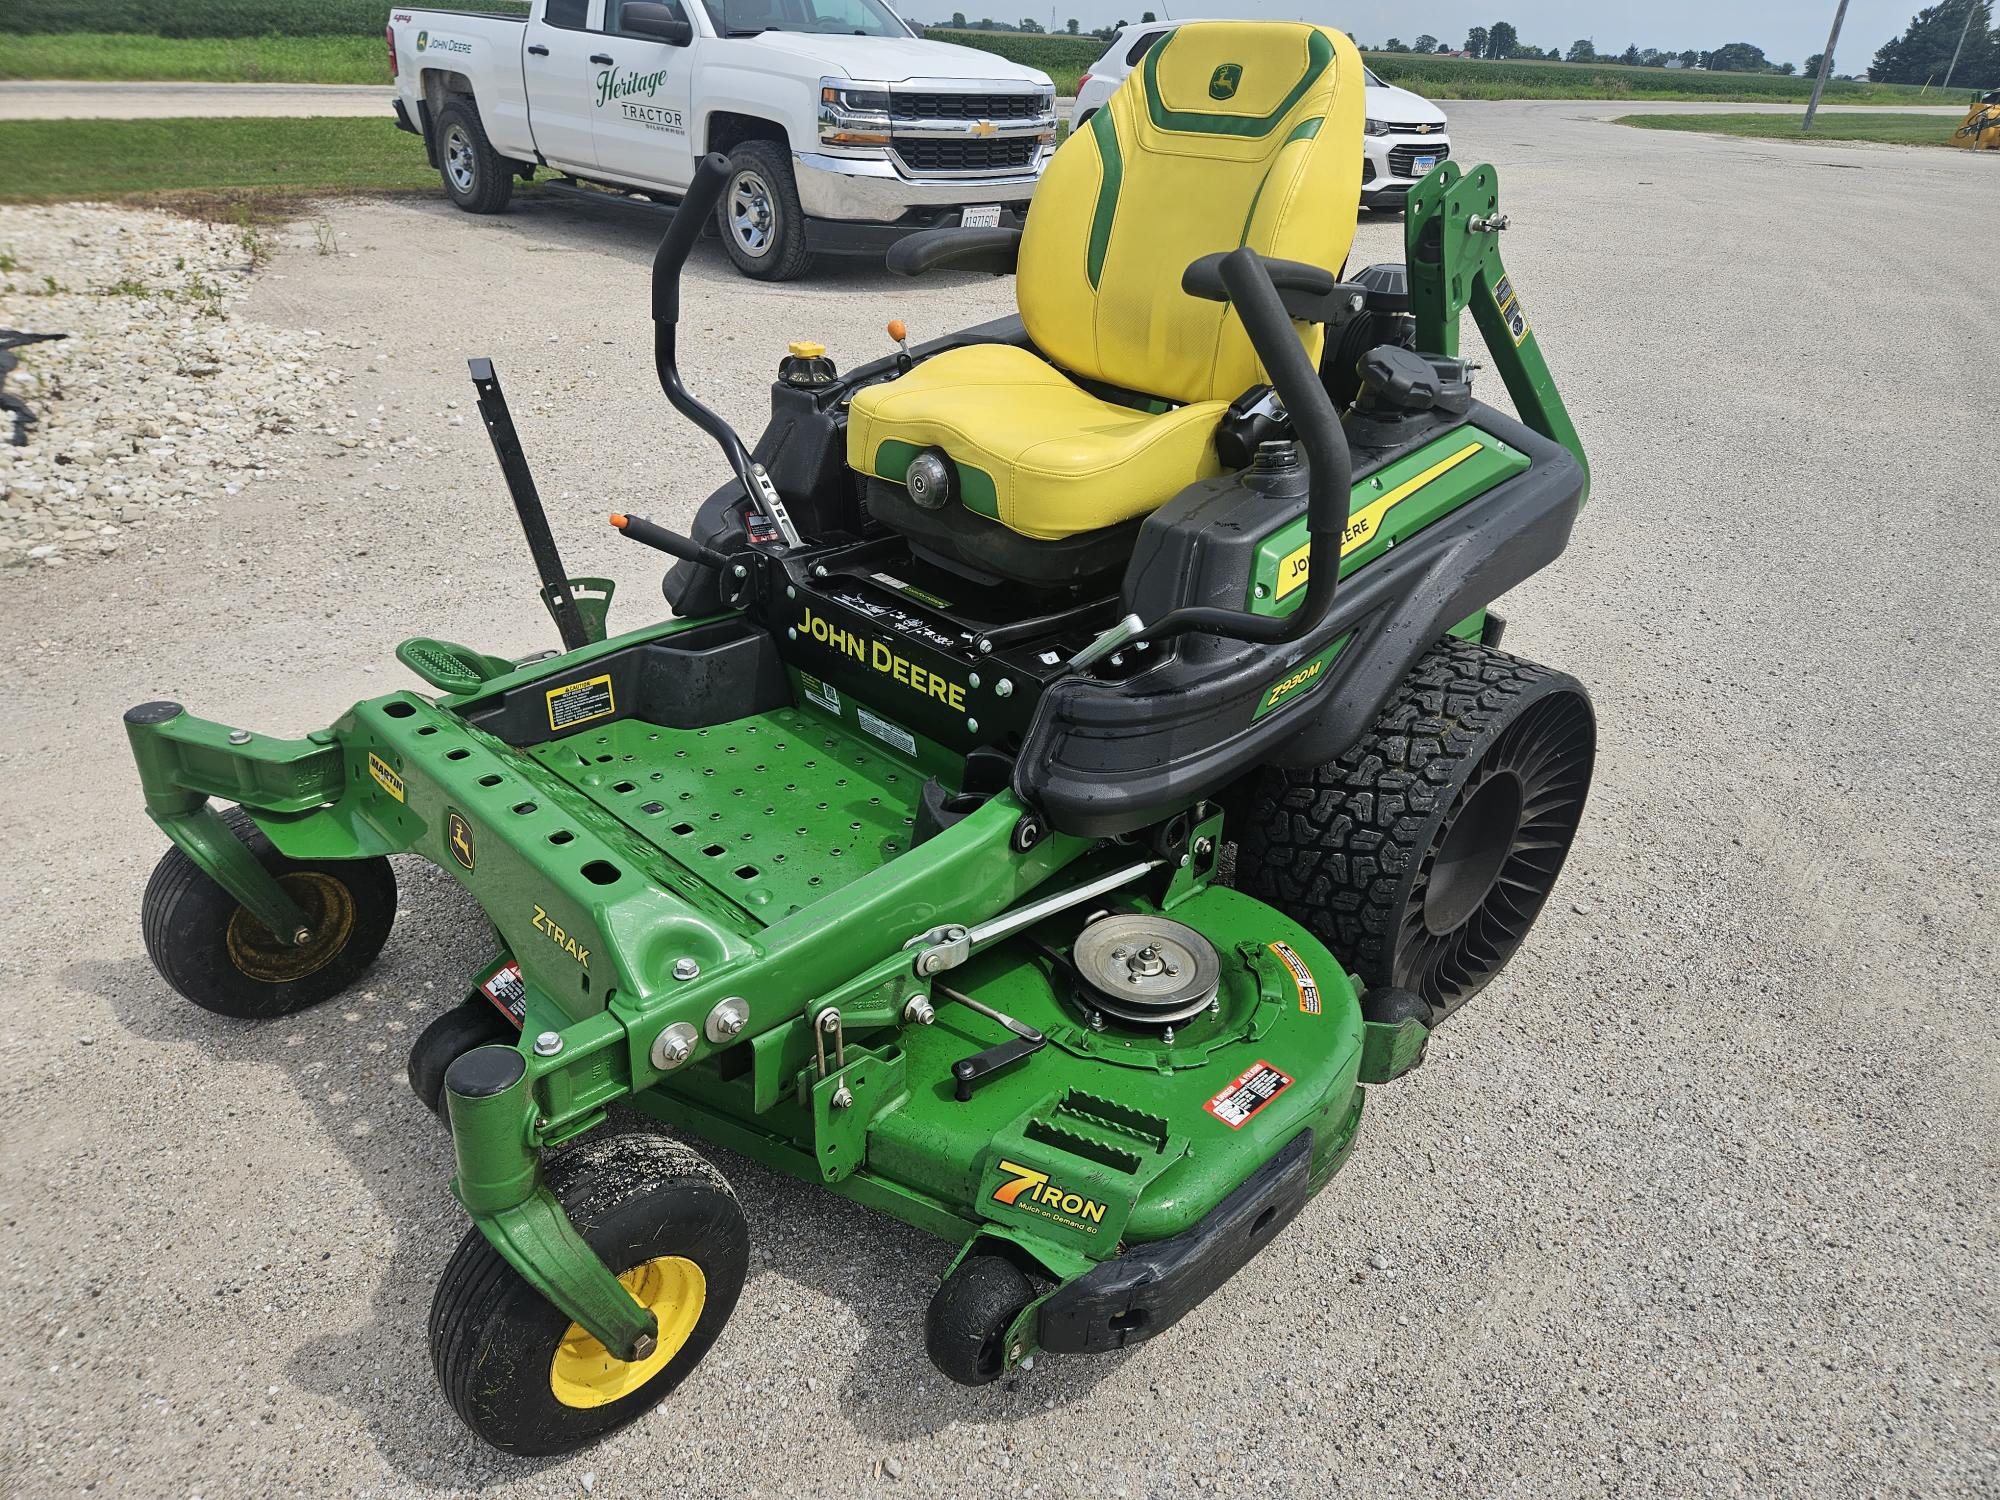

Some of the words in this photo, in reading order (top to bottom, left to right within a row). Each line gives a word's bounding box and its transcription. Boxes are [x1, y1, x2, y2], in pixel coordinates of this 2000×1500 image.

[429, 37, 448, 50] JOHN
[448, 40, 472, 54] DEERE
[596, 66, 667, 108] Heritage
[622, 104, 682, 126] TRACTOR
[1292, 555, 1310, 578] JO
[1340, 518, 1369, 546] ERE
[797, 607, 865, 662] JOHN
[872, 640, 966, 713] DEERE
[1267, 660, 1322, 707] Z930M
[531, 903, 591, 970] ZTRAK
[1018, 1201, 1041, 1215] Mulch
[1041, 1210, 1051, 1219] on
[1052, 1213, 1086, 1231] Demand
[1086, 1226, 1098, 1235] 60
